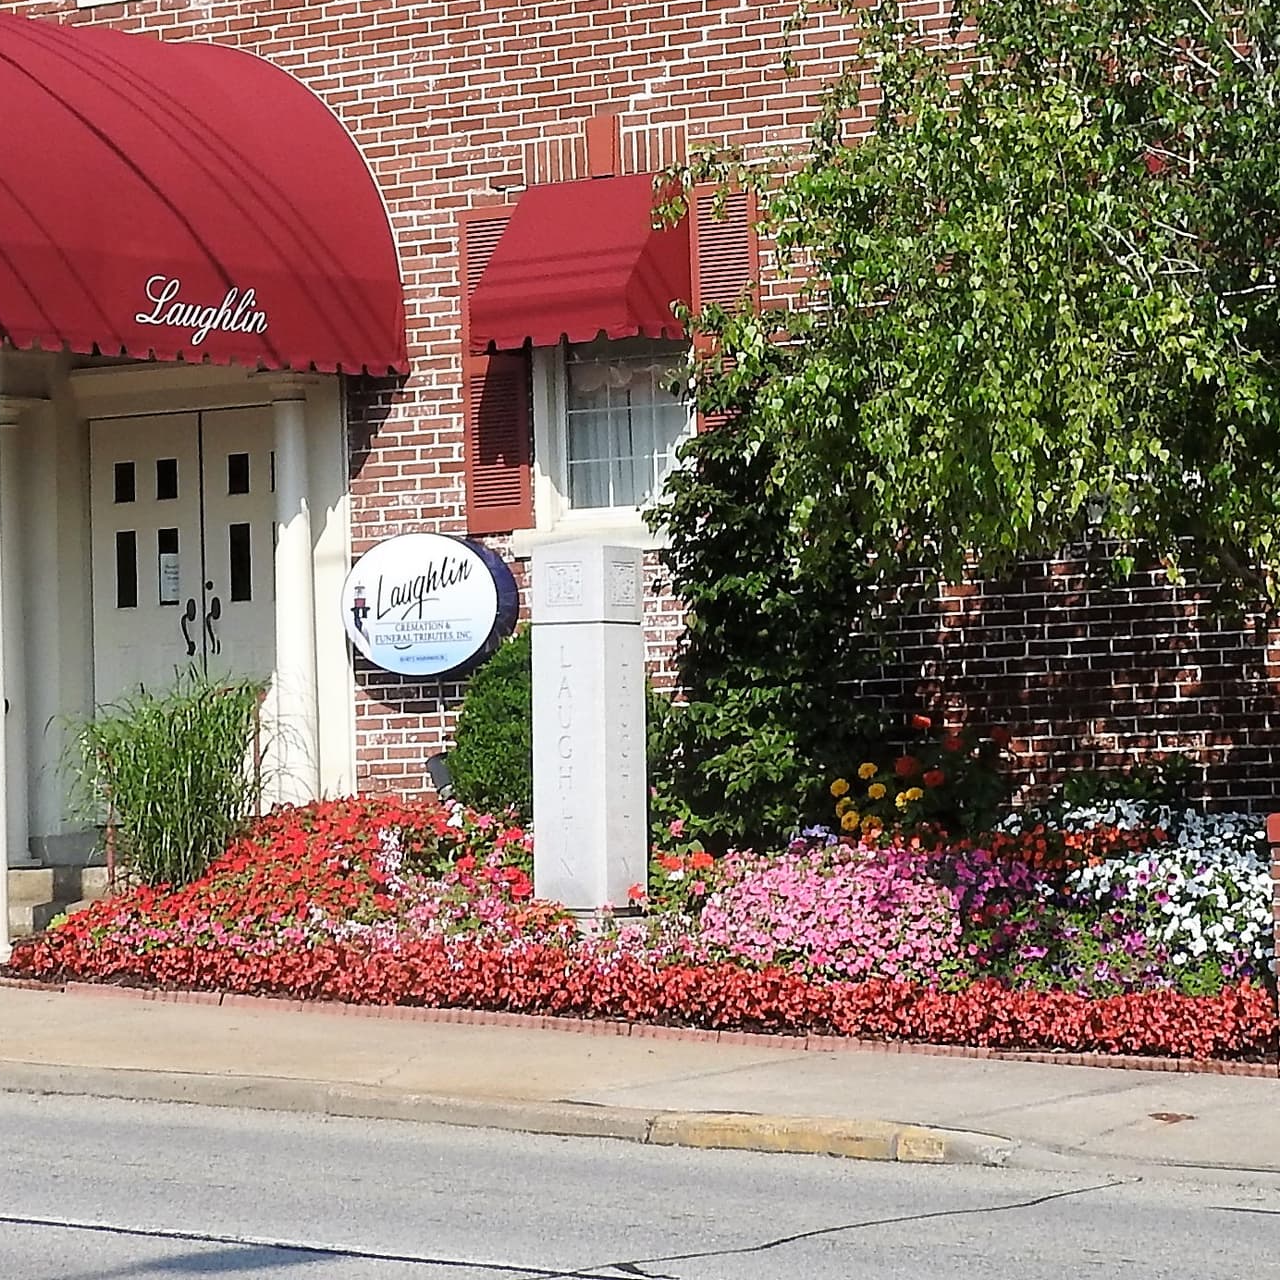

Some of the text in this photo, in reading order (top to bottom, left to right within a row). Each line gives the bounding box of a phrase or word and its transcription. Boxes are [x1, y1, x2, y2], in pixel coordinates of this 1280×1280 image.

[135, 274, 268, 346] Laughlin
[377, 556, 472, 620] Laughlin
[376, 633, 413, 643] FUNERAL
[394, 621, 443, 632] CREMATION
